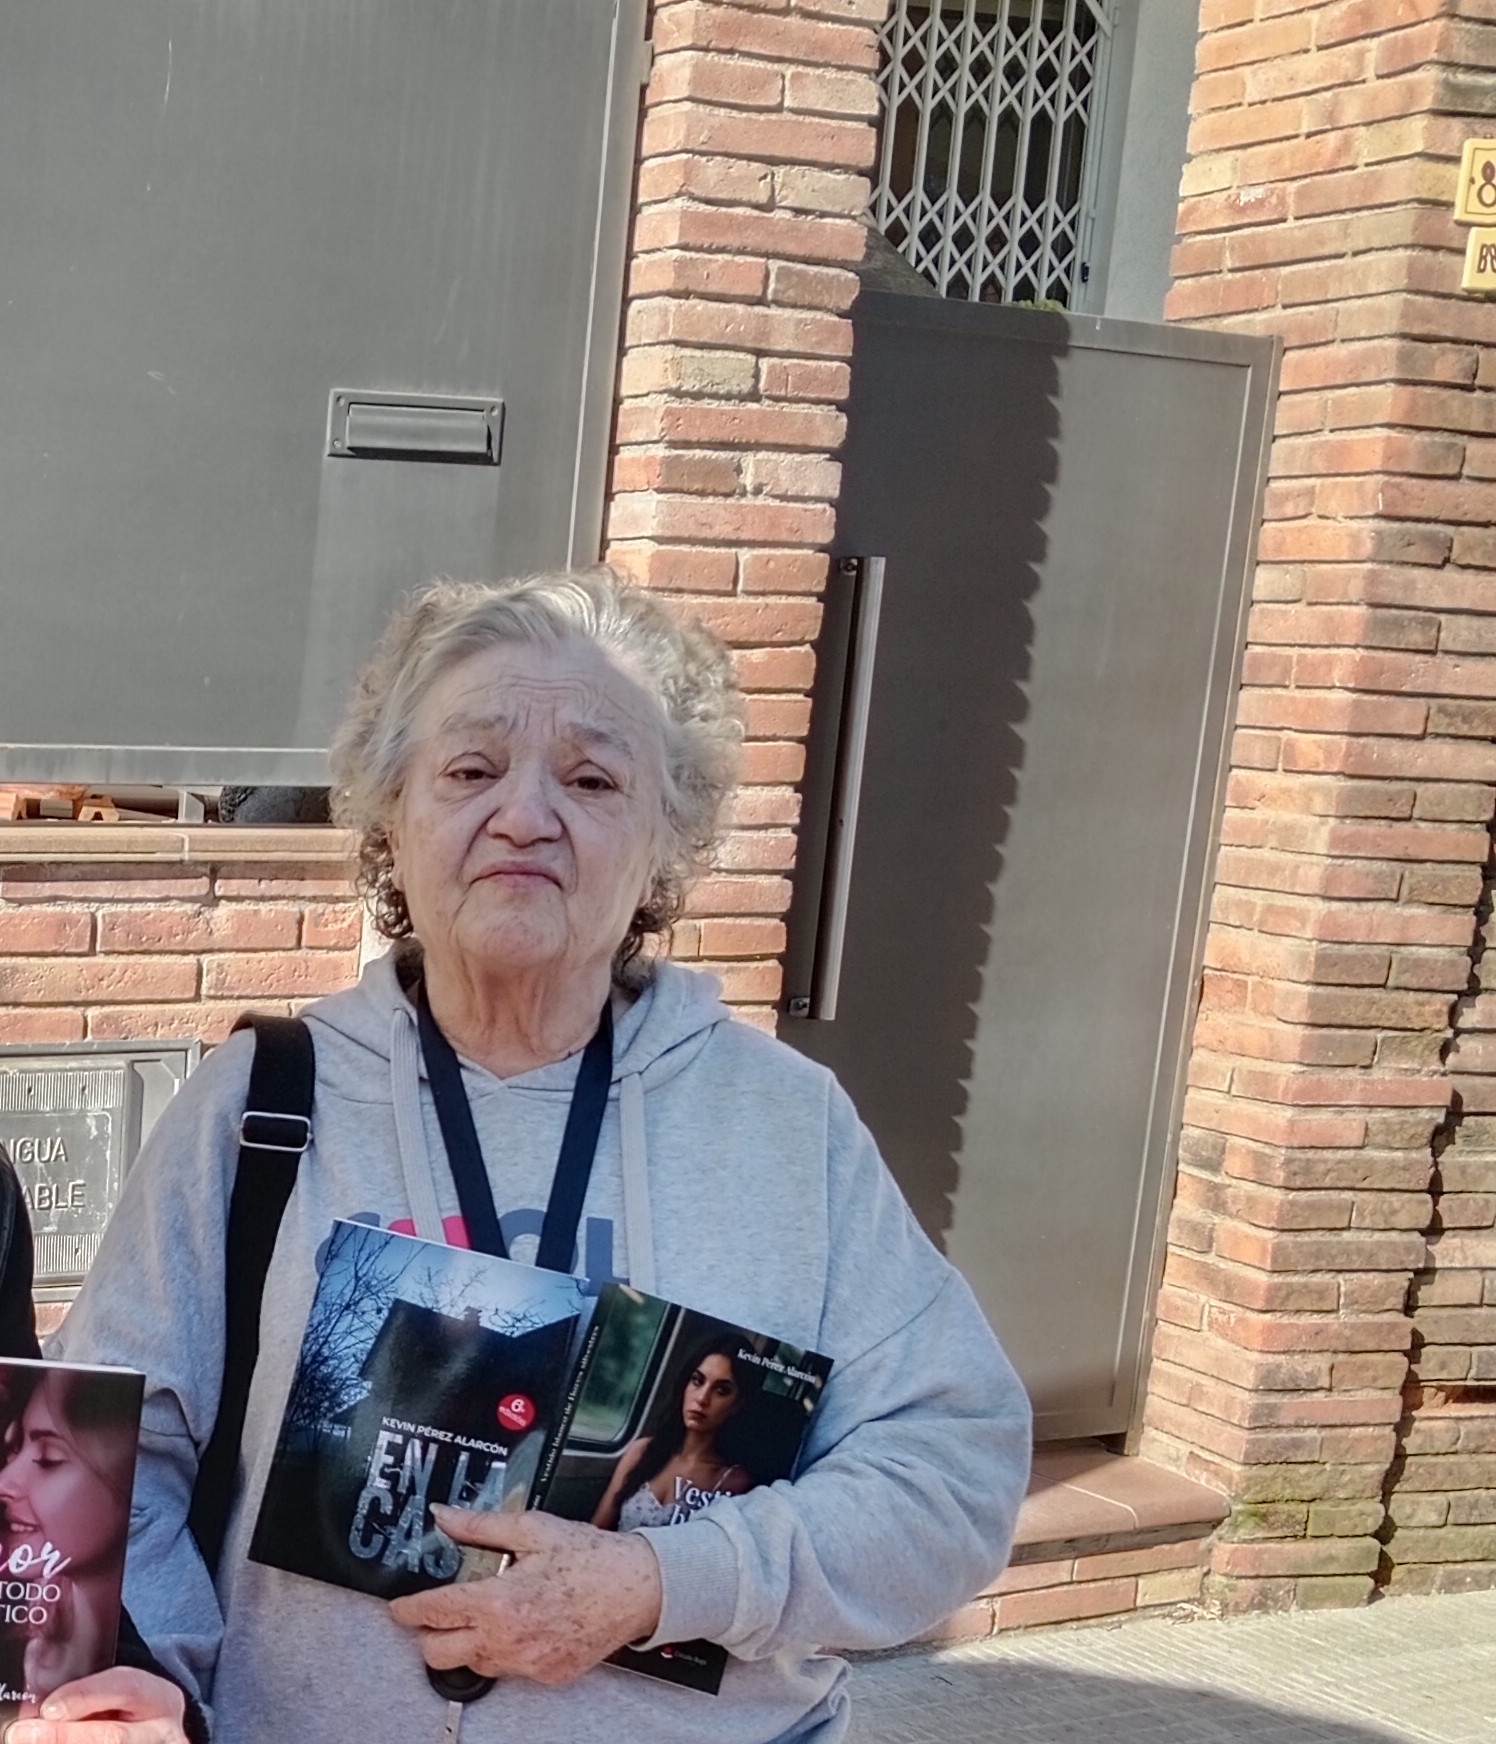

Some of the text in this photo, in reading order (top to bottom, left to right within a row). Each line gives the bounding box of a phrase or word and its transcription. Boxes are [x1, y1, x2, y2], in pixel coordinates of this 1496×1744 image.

[737, 1348, 761, 1365] Kevin
[382, 1416, 508, 1456] KEVIN PÉREZ ALARCÓN
[366, 1430, 507, 1512] EN LA
